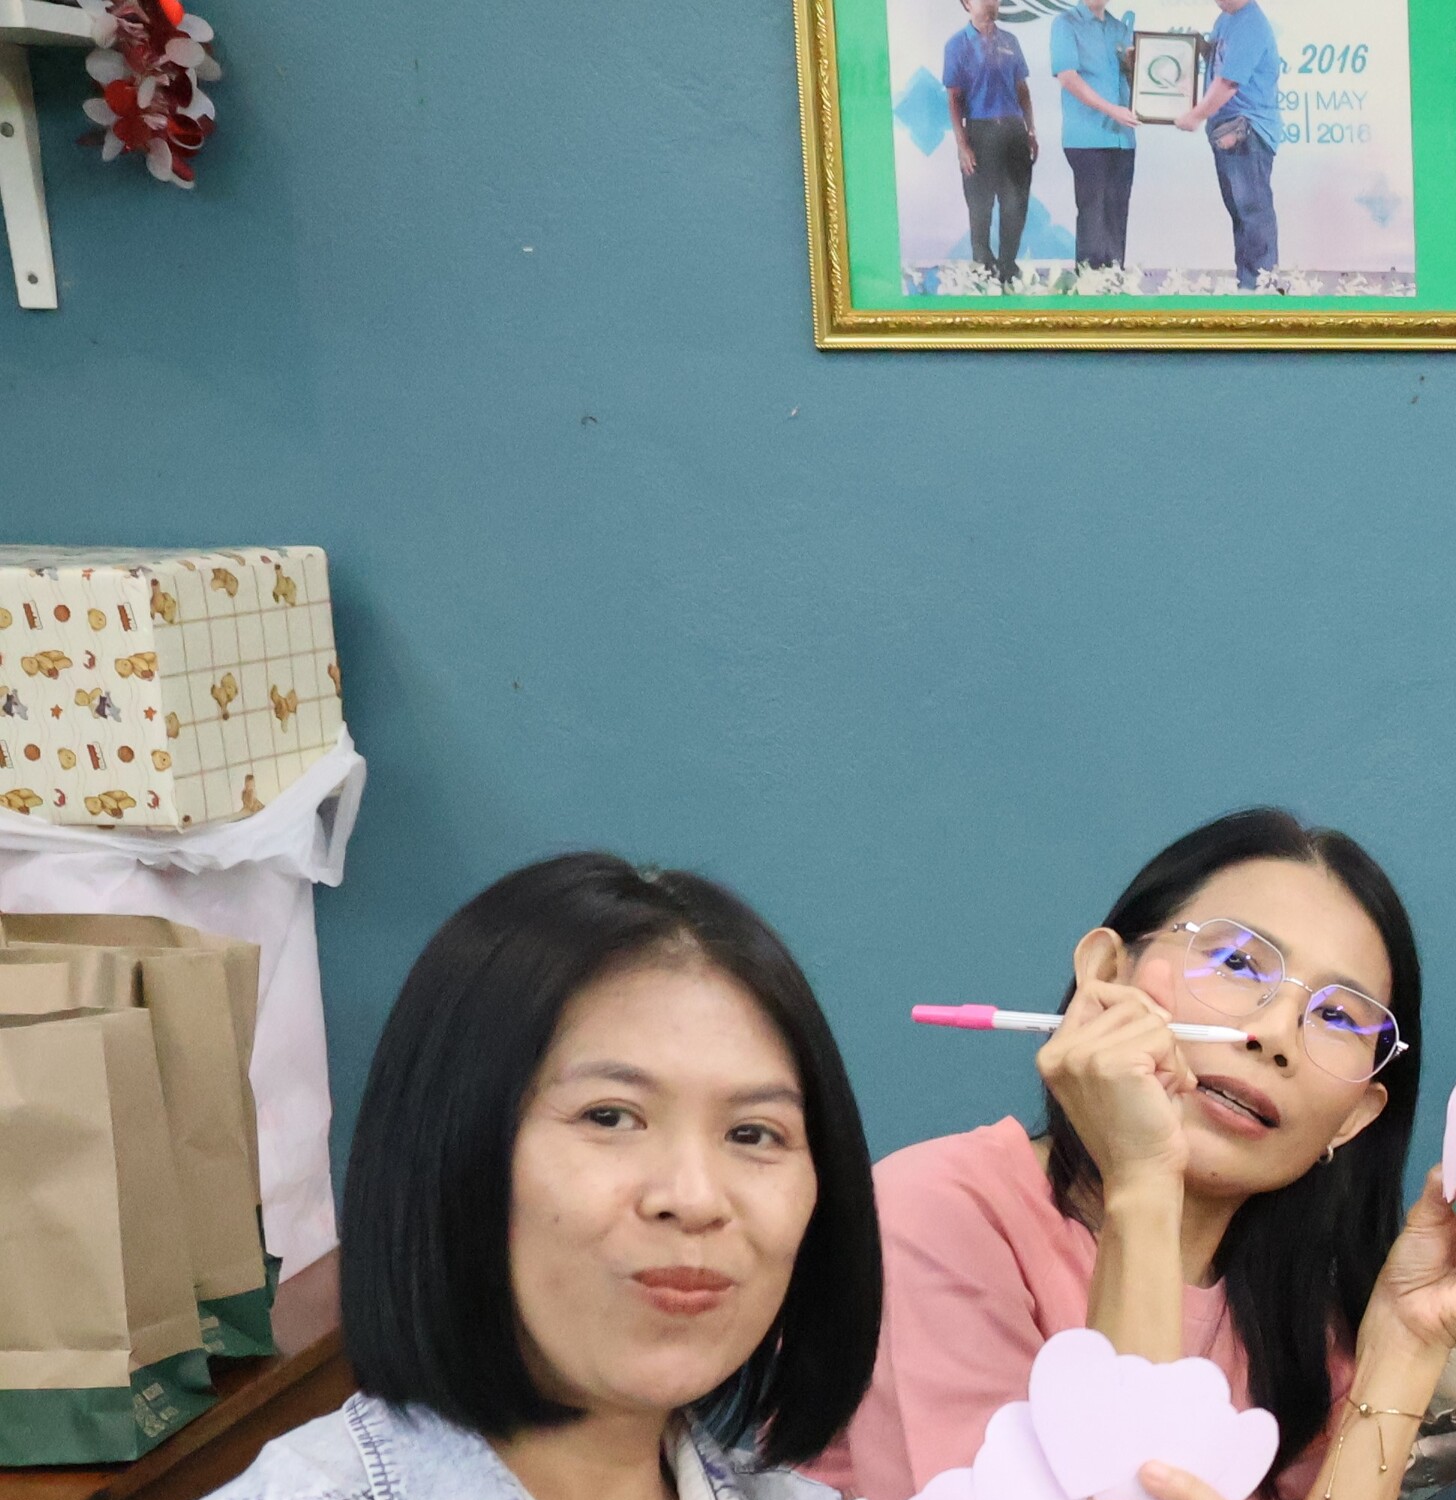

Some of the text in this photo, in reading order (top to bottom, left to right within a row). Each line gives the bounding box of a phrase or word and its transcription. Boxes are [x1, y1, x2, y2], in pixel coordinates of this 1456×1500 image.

[1298, 43, 1369, 74] 2016
[1316, 91, 1368, 111] MAY
[1317, 123, 1371, 144] 2016
